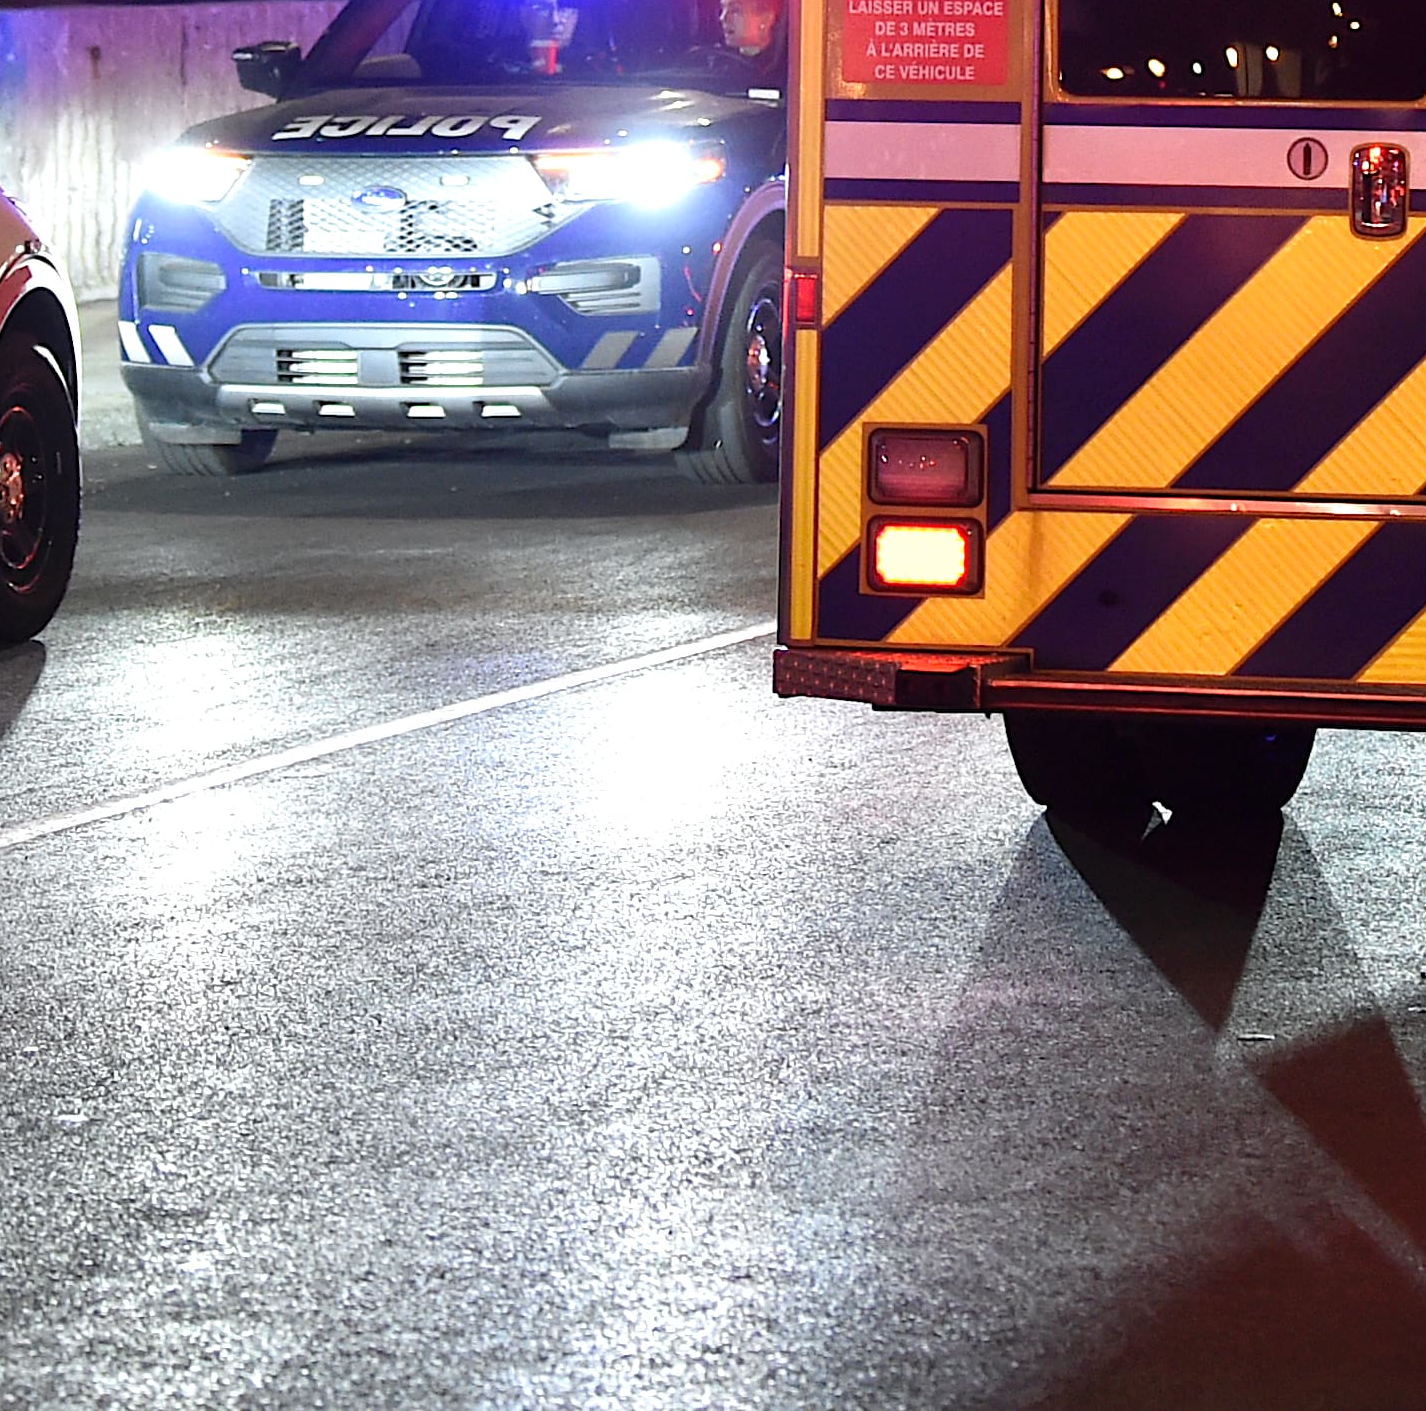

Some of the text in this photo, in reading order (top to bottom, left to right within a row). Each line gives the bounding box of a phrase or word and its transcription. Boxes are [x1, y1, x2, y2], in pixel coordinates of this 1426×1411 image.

[849, 0, 1004, 16] LAISSER UN ESPACE
[875, 18, 975, 37] DE 3 MÈTRES
[866, 39, 985, 58] À L'ARRIÈRE DE
[875, 61, 975, 80] CE VÉHICULE
